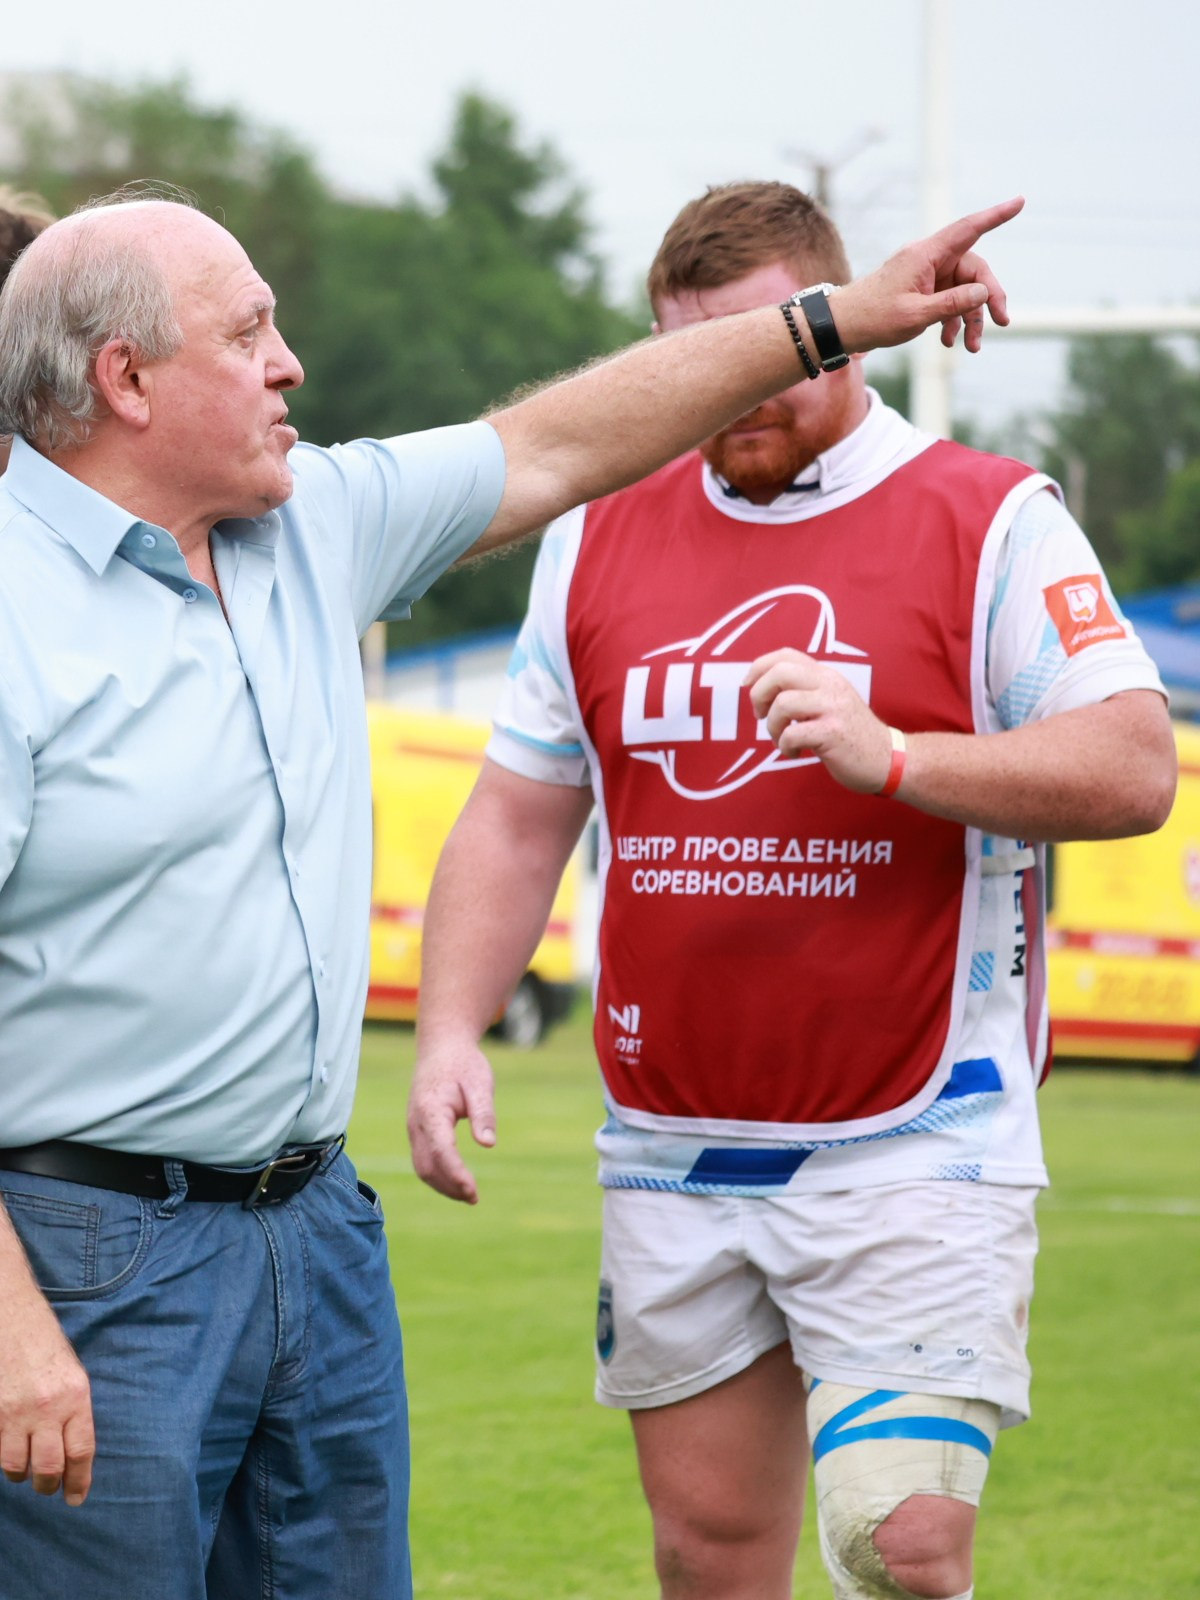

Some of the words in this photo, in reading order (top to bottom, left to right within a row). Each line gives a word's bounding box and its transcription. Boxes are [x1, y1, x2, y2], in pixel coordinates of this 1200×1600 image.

[622, 660, 872, 746] ЦТ
[617, 836, 677, 862] ЦЕНТР
[683, 836, 893, 865] ПРОВЕДЕНИЯ
[631, 868, 857, 898] СОРЕВНОВАНИЙ
